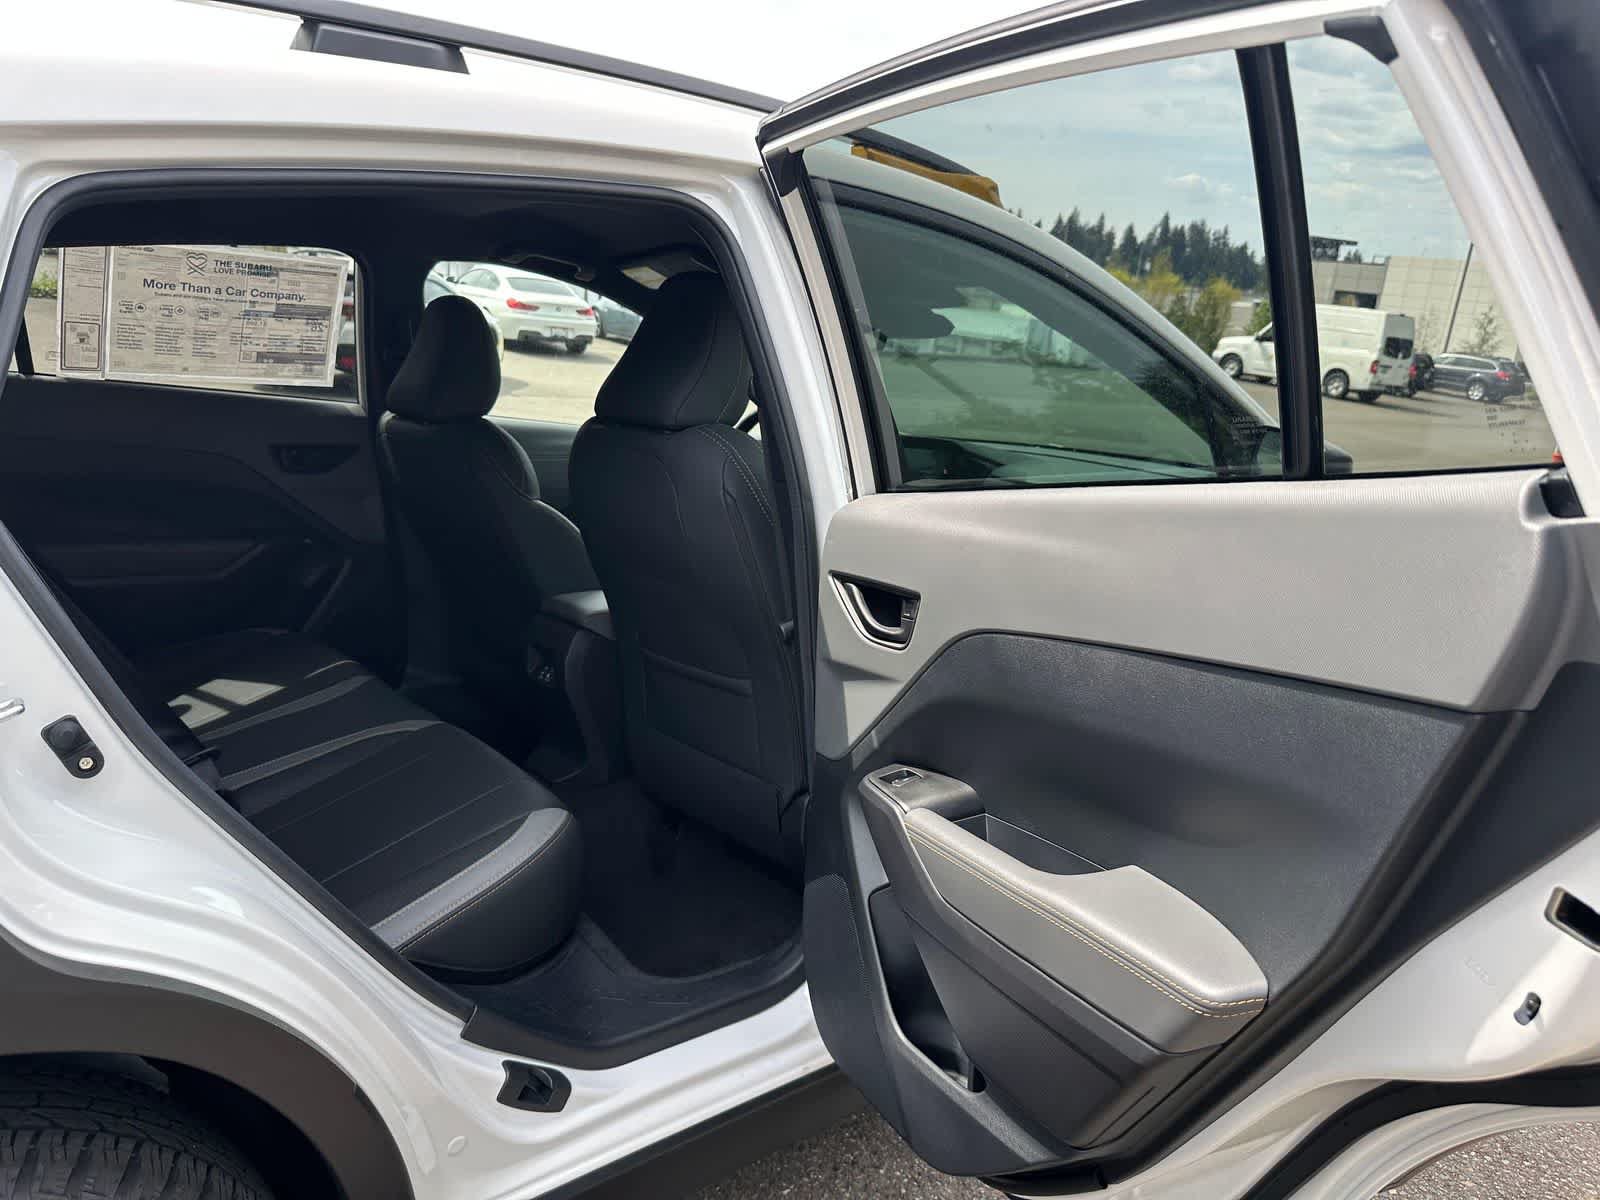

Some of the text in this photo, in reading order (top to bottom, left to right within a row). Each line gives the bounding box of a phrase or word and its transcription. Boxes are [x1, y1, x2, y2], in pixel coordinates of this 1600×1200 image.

[214, 259, 273, 272] THE SUBARU
[214, 267, 234, 275] LOVE
[143, 278, 176, 291] More
[180, 281, 211, 294] Than
[214, 286, 222, 295] a
[225, 286, 247, 297] Car
[250, 288, 306, 302] Company.
